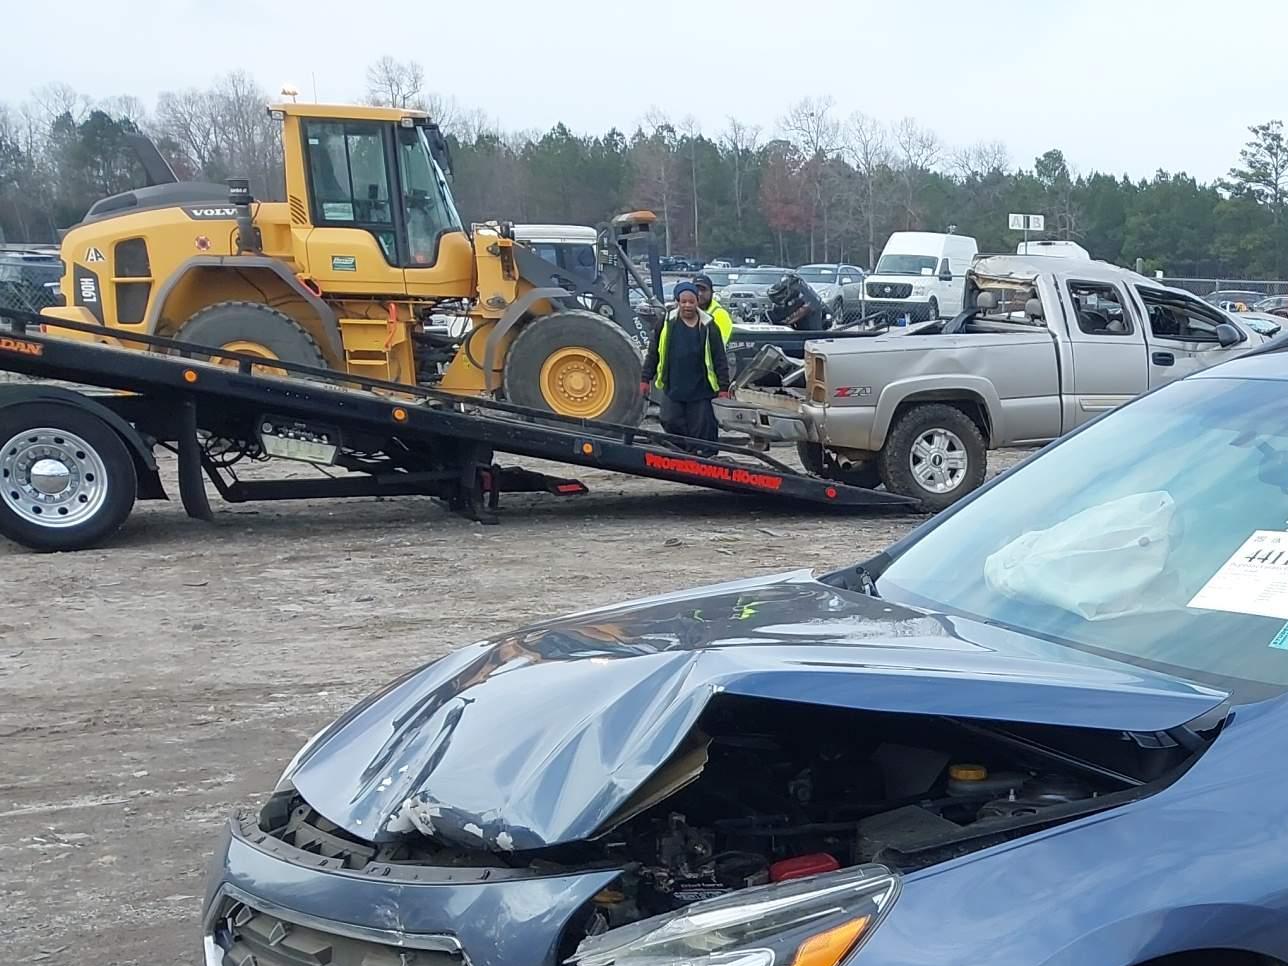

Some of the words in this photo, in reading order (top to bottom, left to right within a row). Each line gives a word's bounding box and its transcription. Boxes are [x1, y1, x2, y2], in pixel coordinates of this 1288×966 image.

[191, 208, 238, 216] VOLV
[80, 278, 97, 303] L90H
[833, 386, 872, 398] Z71
[645, 453, 731, 479] PROFESSIONAL
